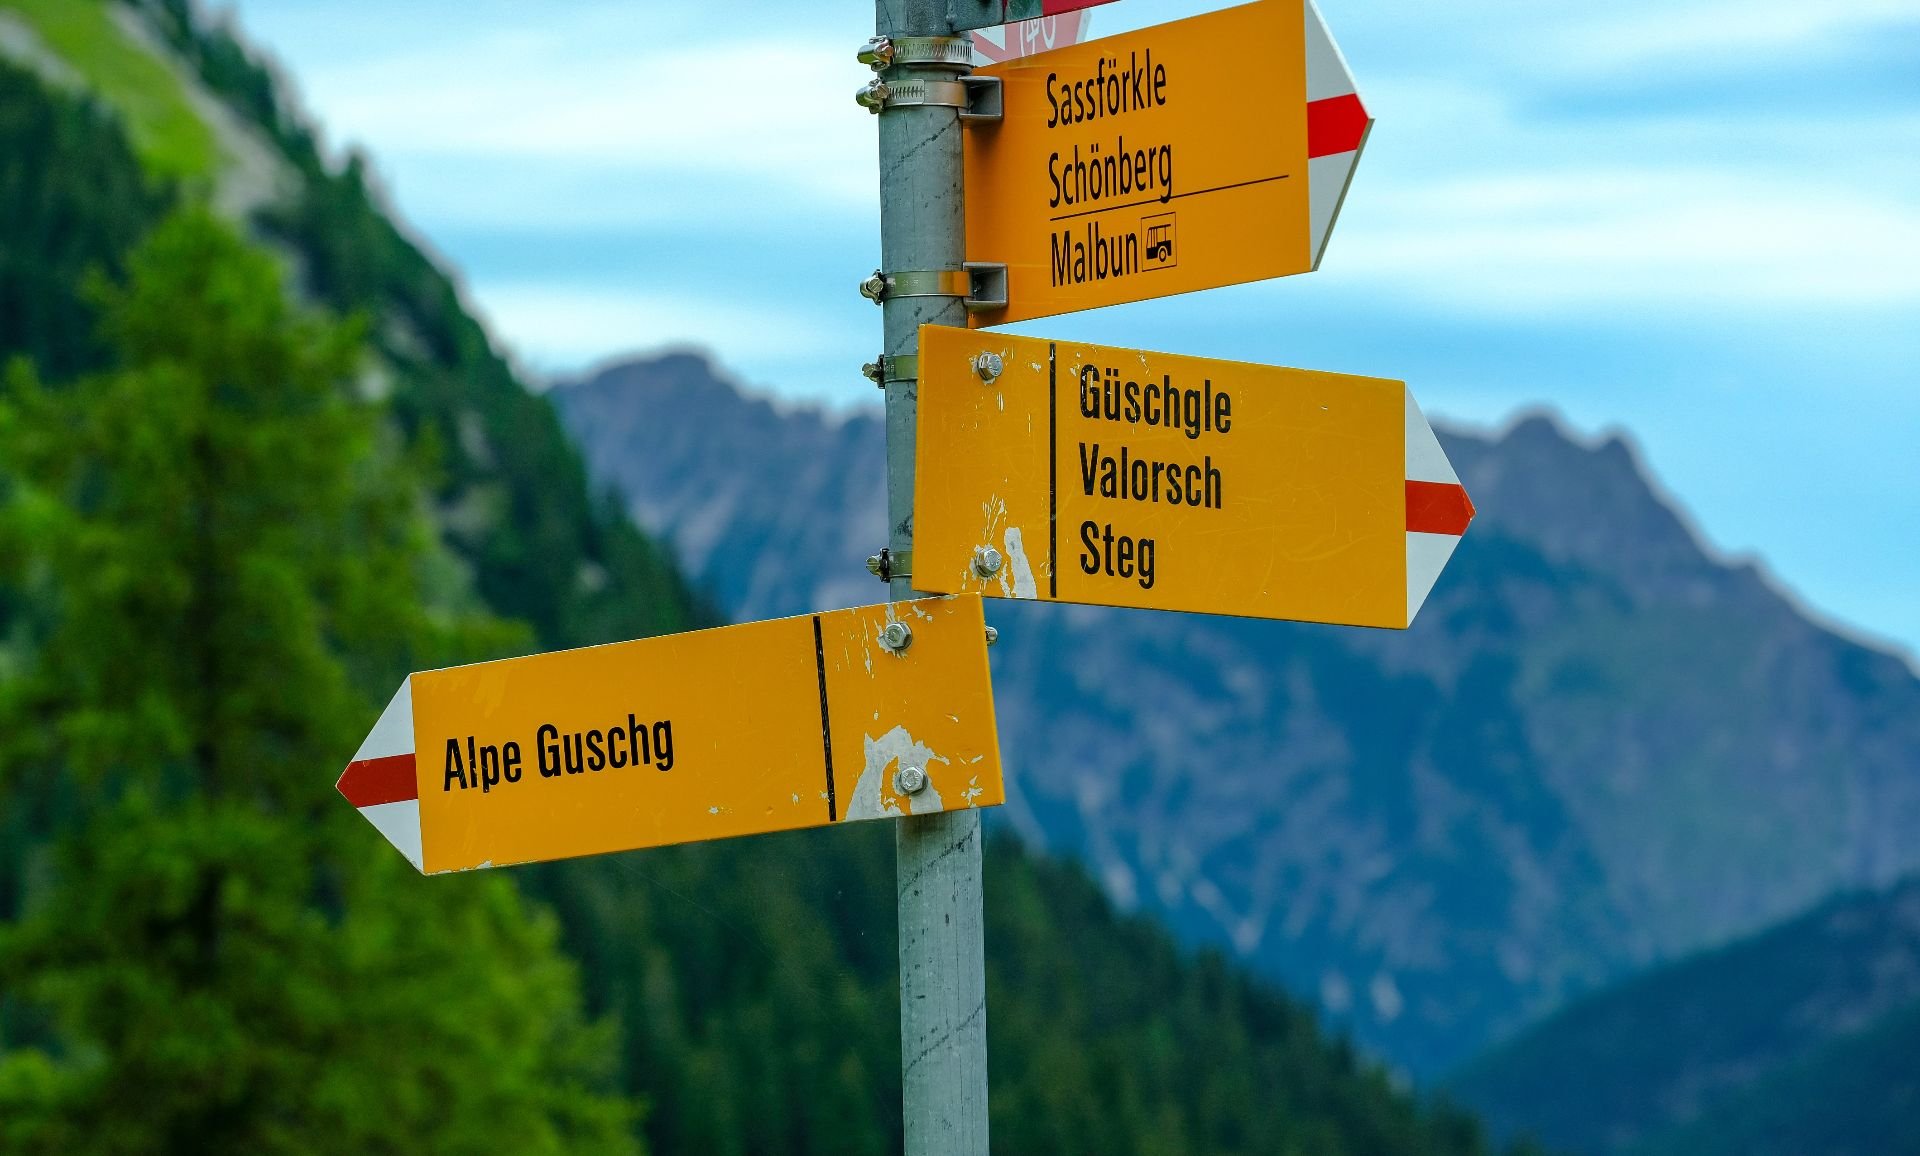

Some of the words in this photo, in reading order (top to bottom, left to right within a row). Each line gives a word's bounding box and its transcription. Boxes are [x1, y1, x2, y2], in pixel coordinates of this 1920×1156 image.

[1046, 47, 1167, 129] Sassförkle
[1048, 135, 1173, 209] Schönberg
[1051, 221, 1138, 288] Malbun
[1079, 363, 1232, 440] Güschgle
[1078, 442, 1222, 510] Valorsch
[1080, 520, 1155, 590] Steg
[443, 735, 522, 794] Alpe
[537, 713, 674, 779] Guschg
